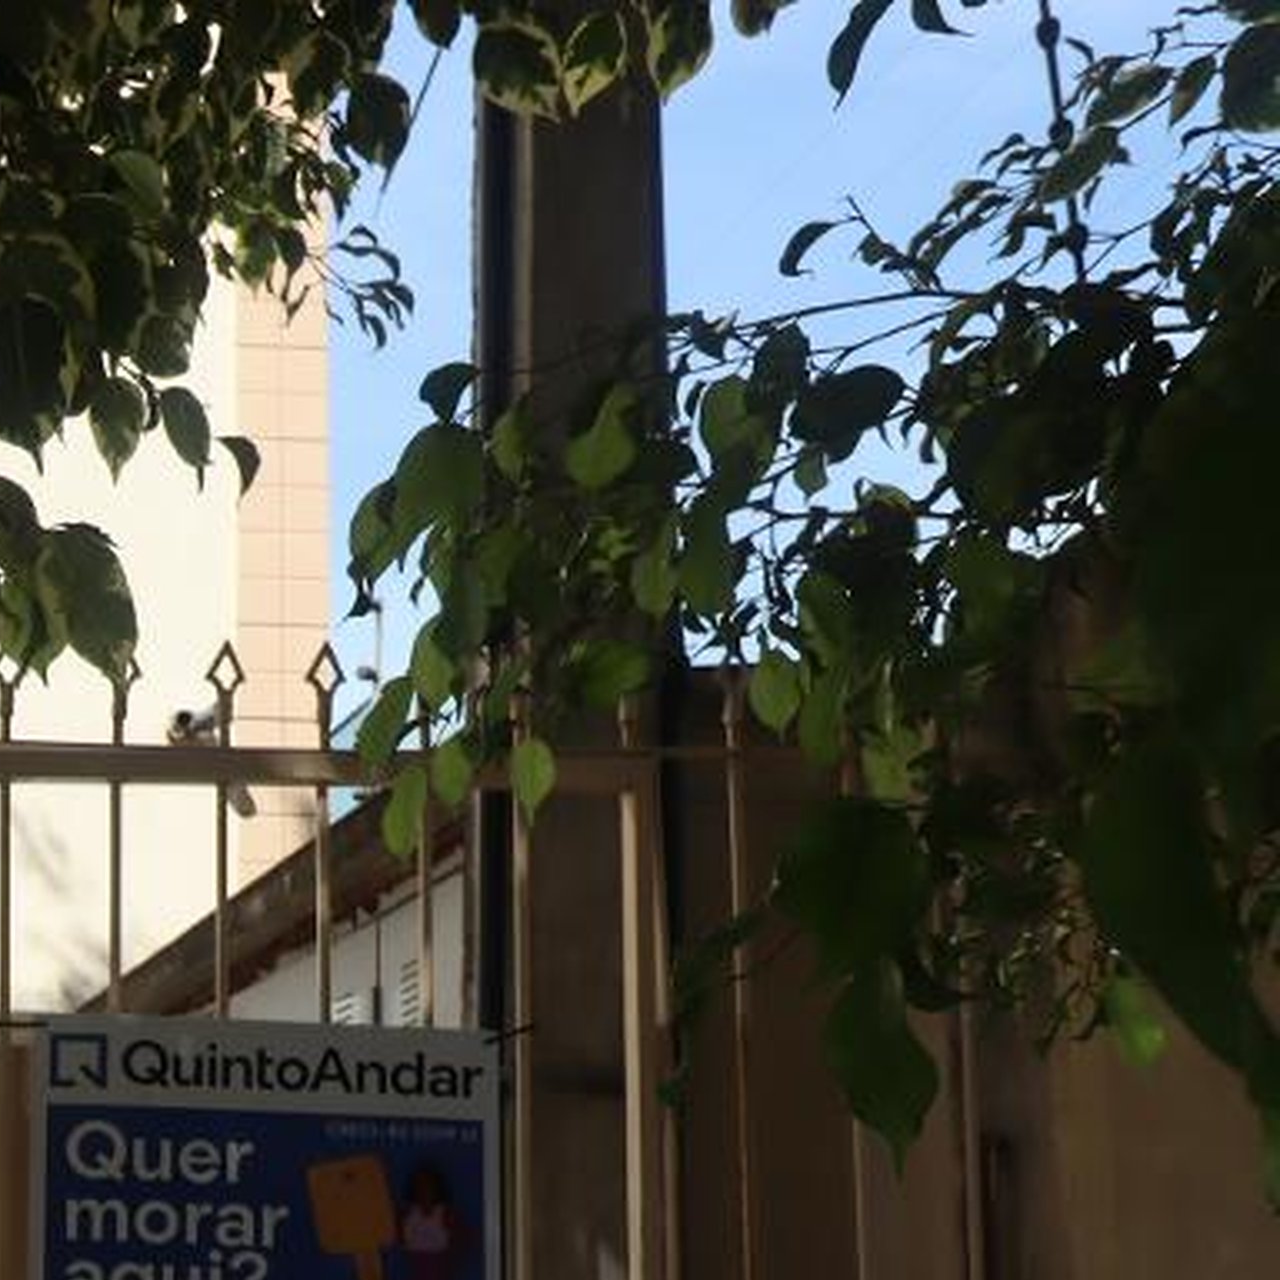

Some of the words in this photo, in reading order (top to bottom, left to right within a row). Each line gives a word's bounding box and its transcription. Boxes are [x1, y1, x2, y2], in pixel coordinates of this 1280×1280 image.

[121, 1040, 484, 1099] QuintoAndar
[64, 1119, 254, 1185] Quer
[64, 1197, 289, 1249] morar
